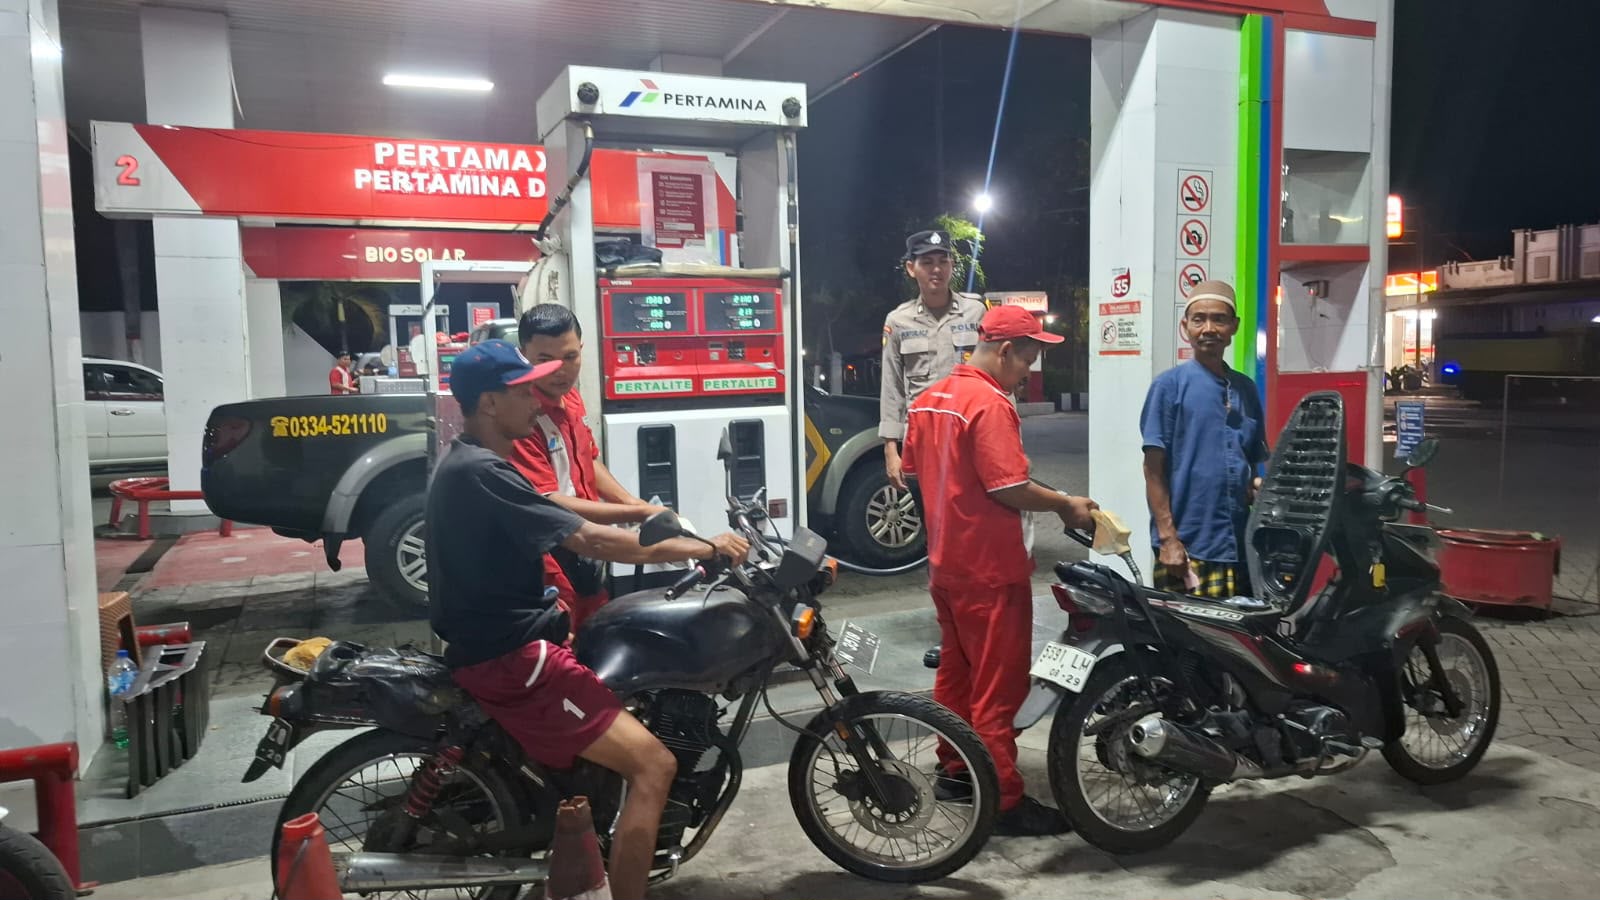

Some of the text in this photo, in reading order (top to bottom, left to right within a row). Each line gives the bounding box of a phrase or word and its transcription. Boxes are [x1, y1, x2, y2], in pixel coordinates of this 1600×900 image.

[664, 93, 767, 112] PERTAMINA
[115, 155, 141, 187] 2
[354, 169, 521, 197] PERTAMINA
[616, 380, 692, 394] PERTALITE
[703, 378, 776, 391] PERTALITE
[290, 413, 387, 437] 0334-521110
[563, 698, 586, 720] 1
